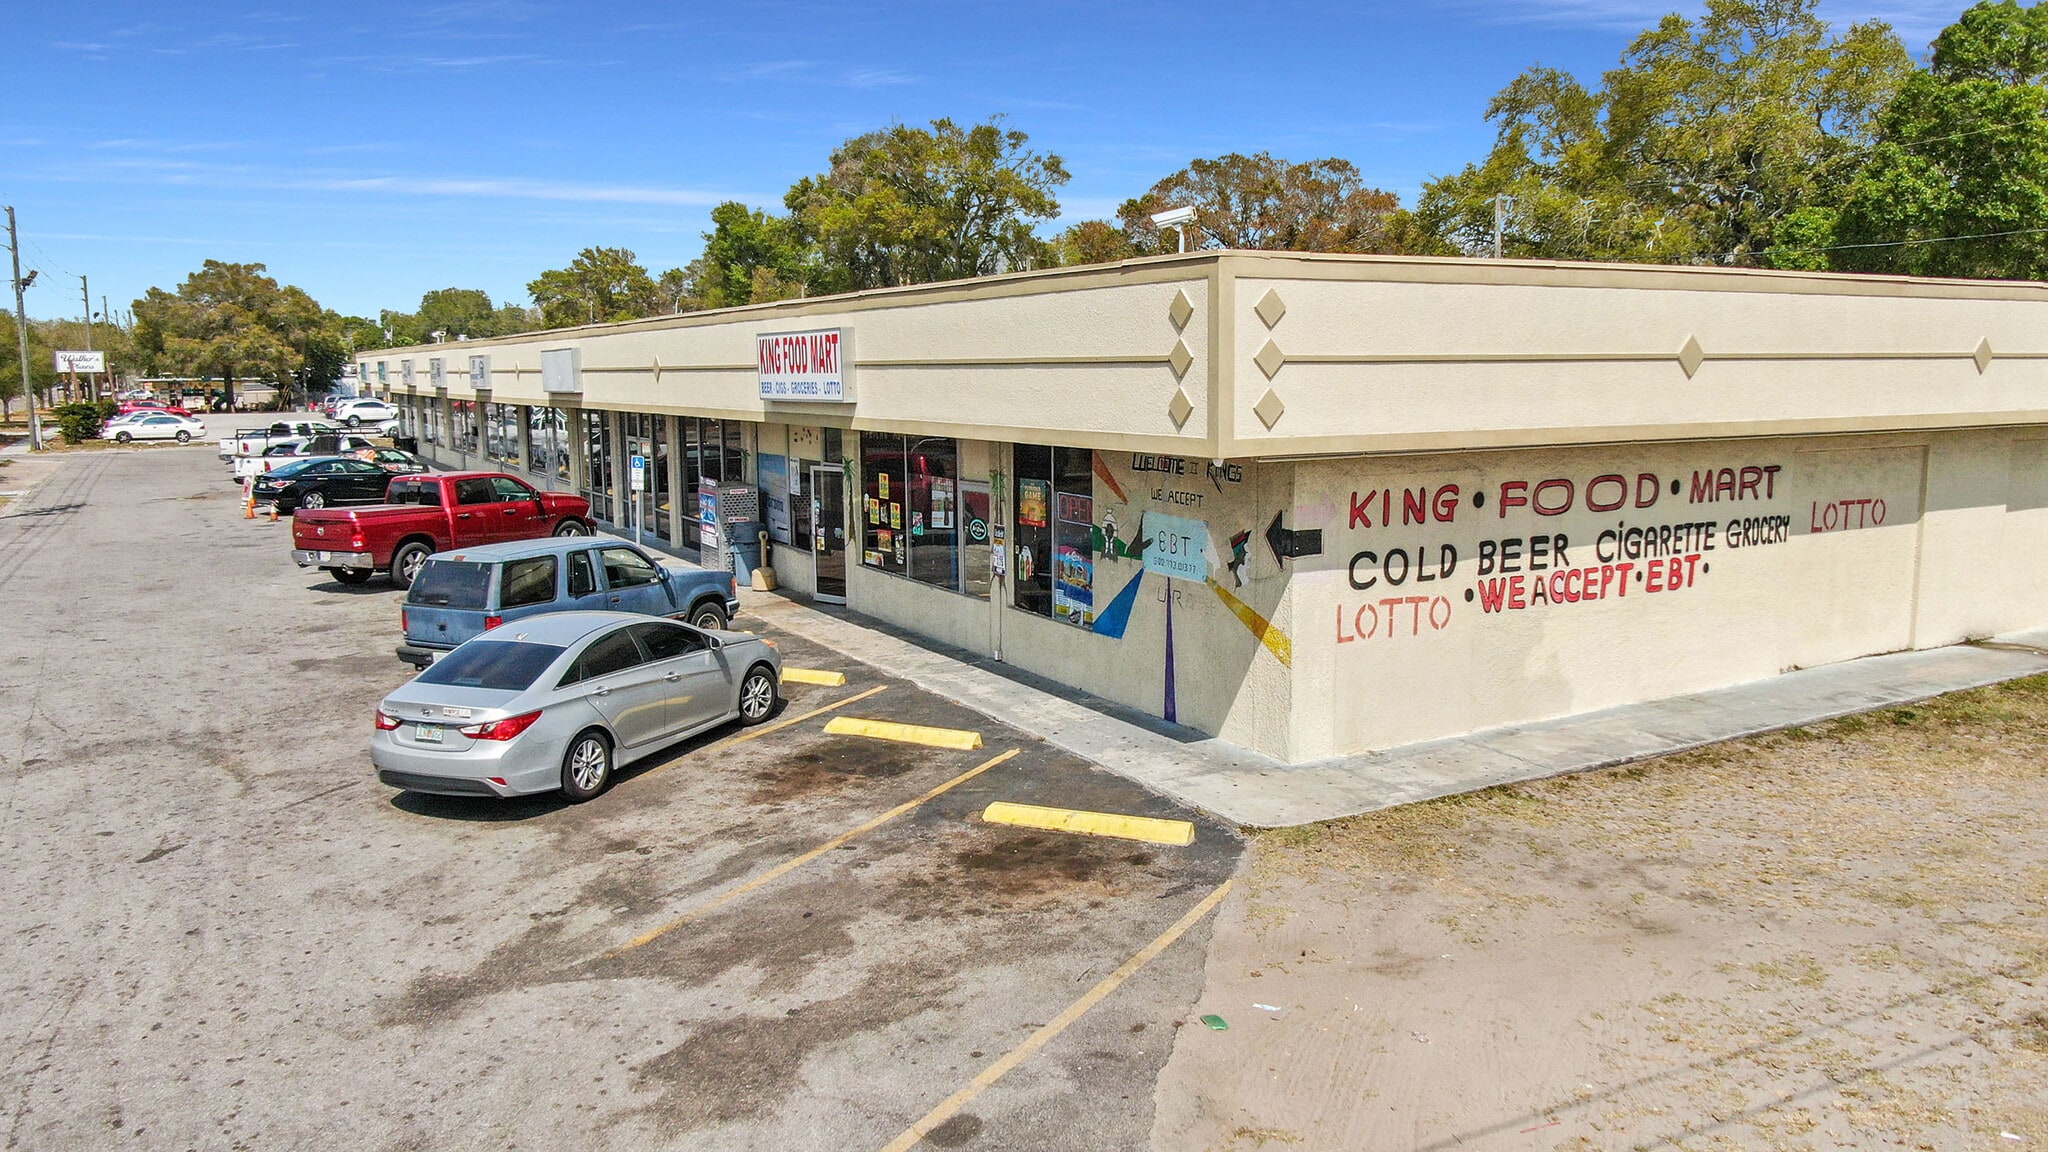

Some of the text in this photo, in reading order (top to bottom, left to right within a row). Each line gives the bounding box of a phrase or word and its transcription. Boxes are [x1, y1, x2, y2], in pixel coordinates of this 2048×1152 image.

[759, 334, 838, 374] KING FOOD MART
[761, 381, 841, 394] BEER CIGS GROCERIES LOTTO
[1131, 454, 1185, 475] WELCOME
[1151, 488, 1204, 508] WE ACCEPT
[1349, 465, 1782, 530] KING FOOD MART
[1810, 498, 1887, 533] LOTTO
[1158, 530, 1191, 557] EBT
[1349, 543, 1458, 591] COLD
[1477, 533, 1570, 576] BEER
[1725, 515, 1791, 549] GROCERY
[1477, 554, 1701, 613] WE ACCEPT EBT
[1337, 596, 1451, 643] LOTTO
